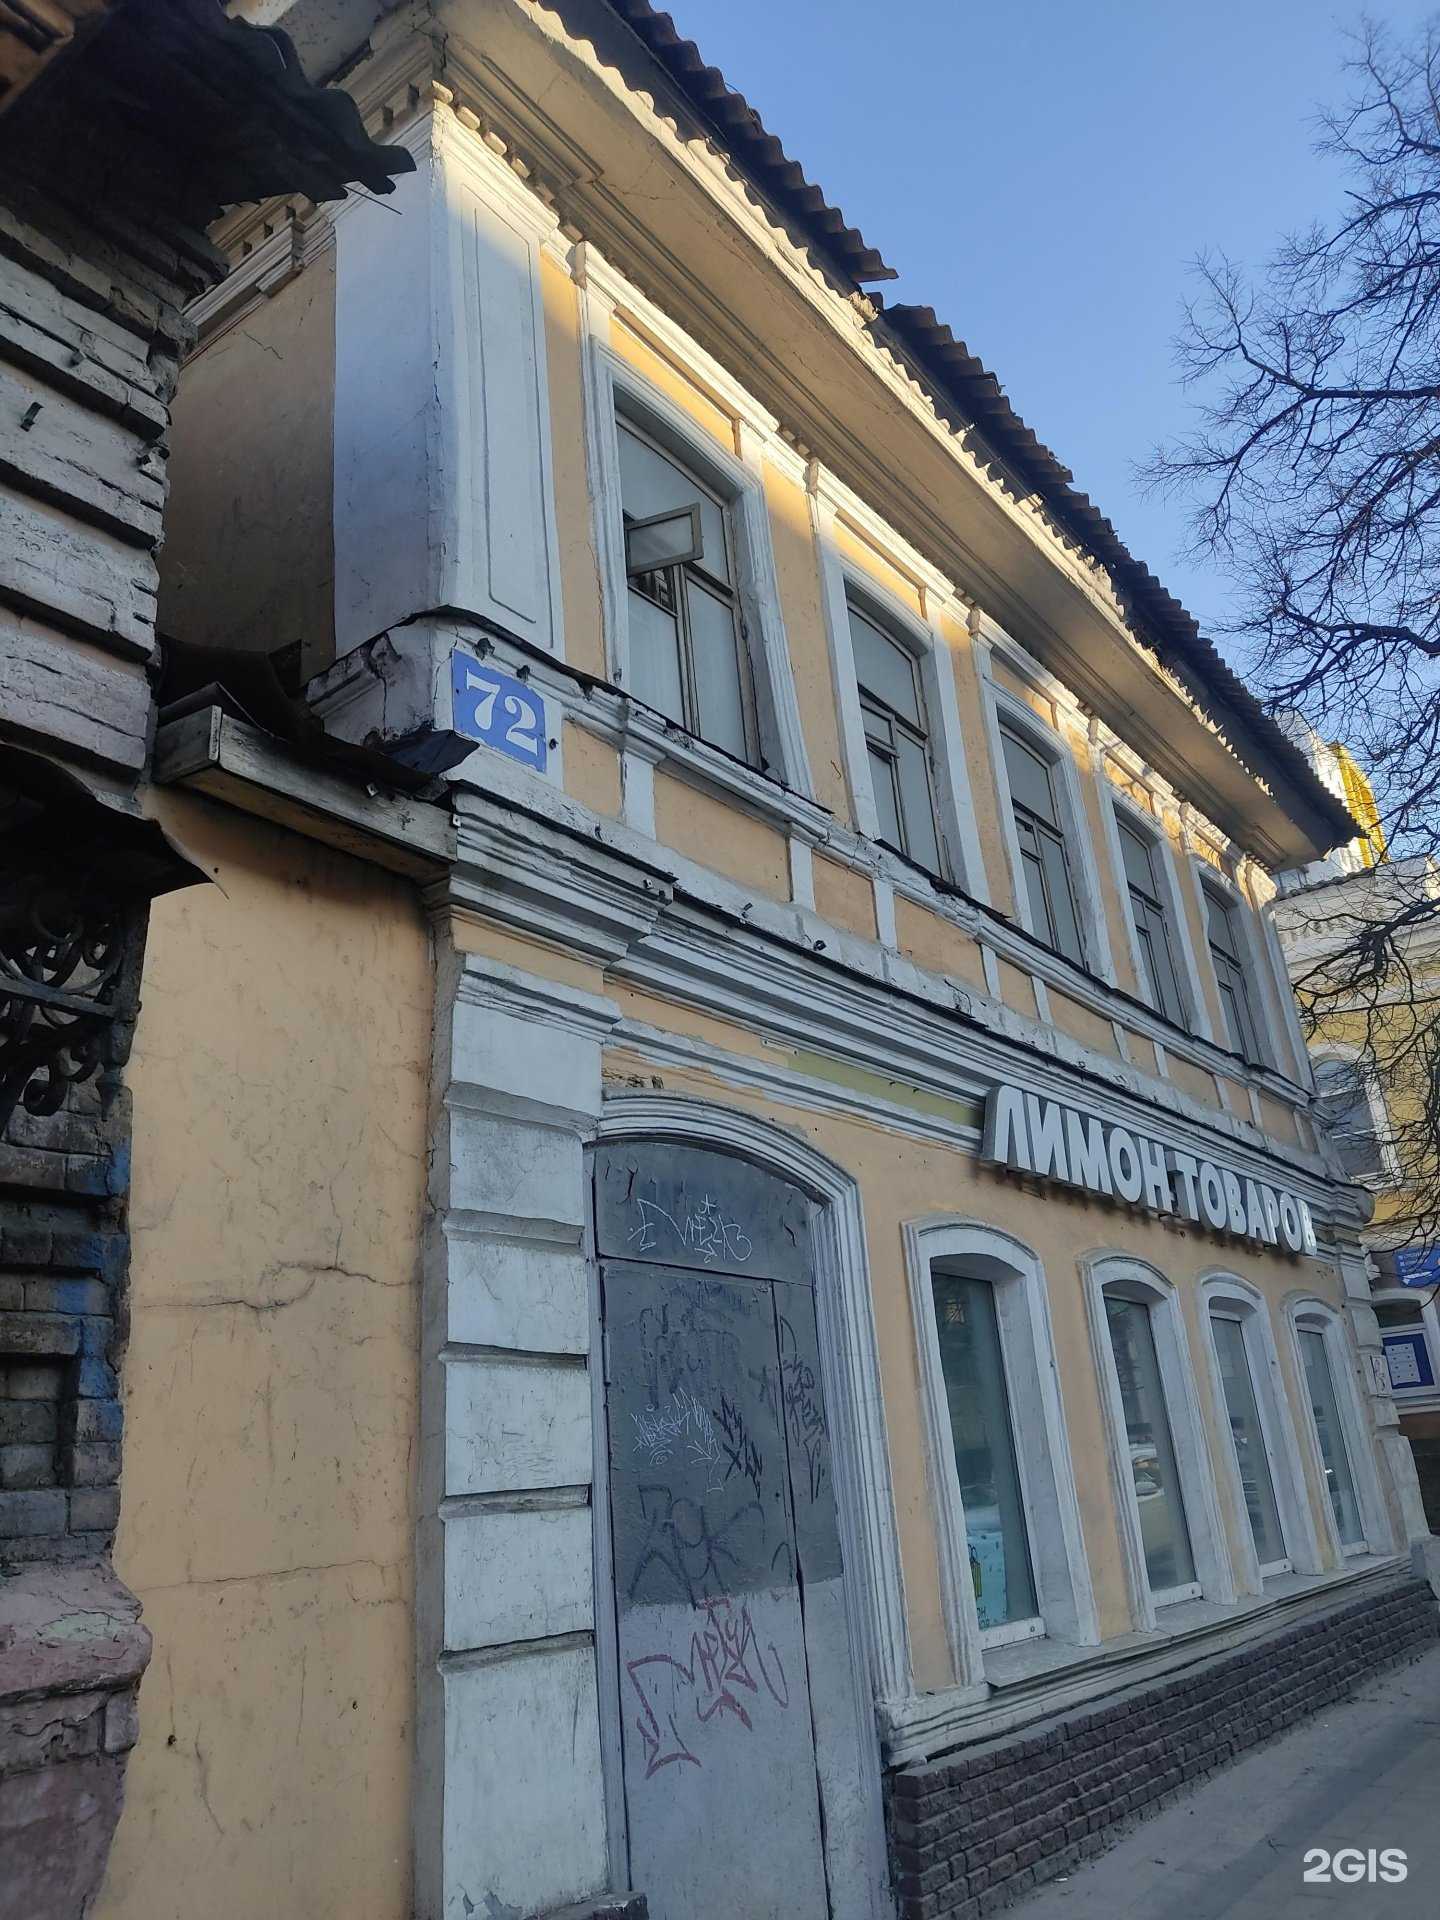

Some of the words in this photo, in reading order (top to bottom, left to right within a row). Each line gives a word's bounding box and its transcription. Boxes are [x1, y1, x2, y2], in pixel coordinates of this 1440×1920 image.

[466, 667, 538, 756] 72
[994, 1084, 1174, 1214] ЛИМОН
[1174, 1150, 1318, 1256] ТОВАРОВ
